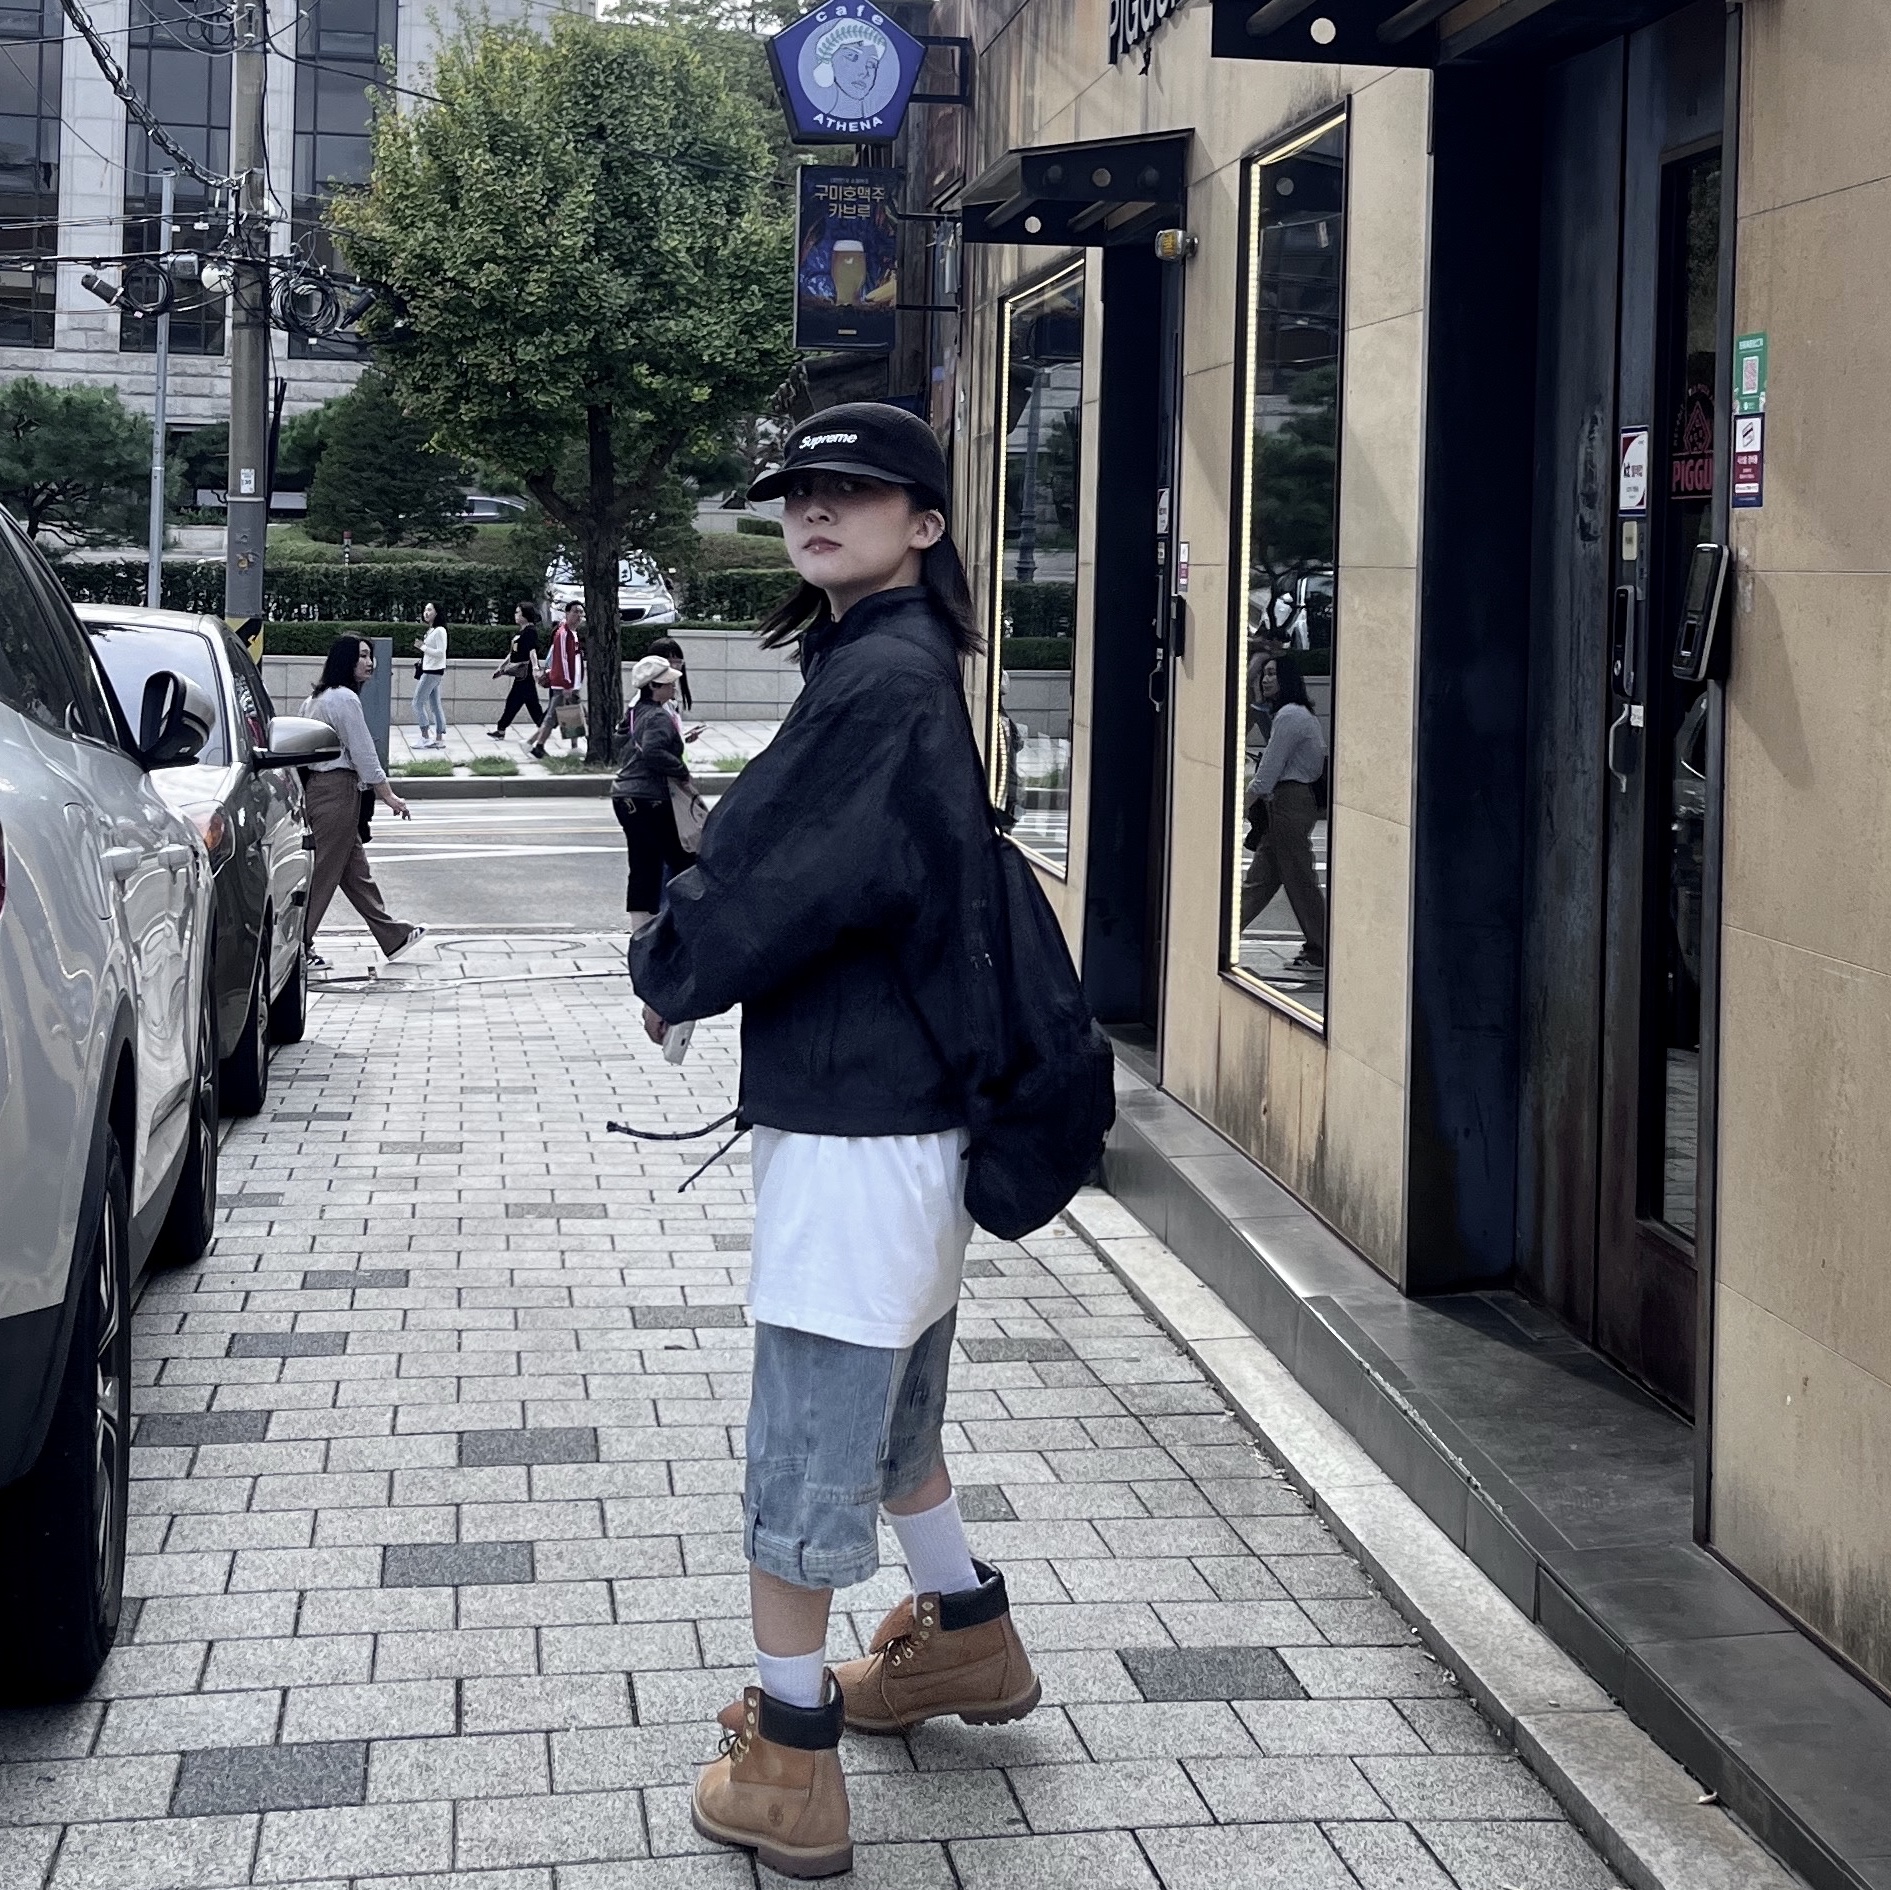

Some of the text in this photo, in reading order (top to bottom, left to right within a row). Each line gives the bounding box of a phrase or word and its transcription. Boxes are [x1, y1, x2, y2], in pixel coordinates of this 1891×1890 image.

[816, 4, 884, 26] cafe
[813, 113, 884, 132] ATHENA
[815, 184, 885, 202] 구미호맥주
[828, 203, 871, 220] 카브루
[799, 433, 858, 449] Supreme
